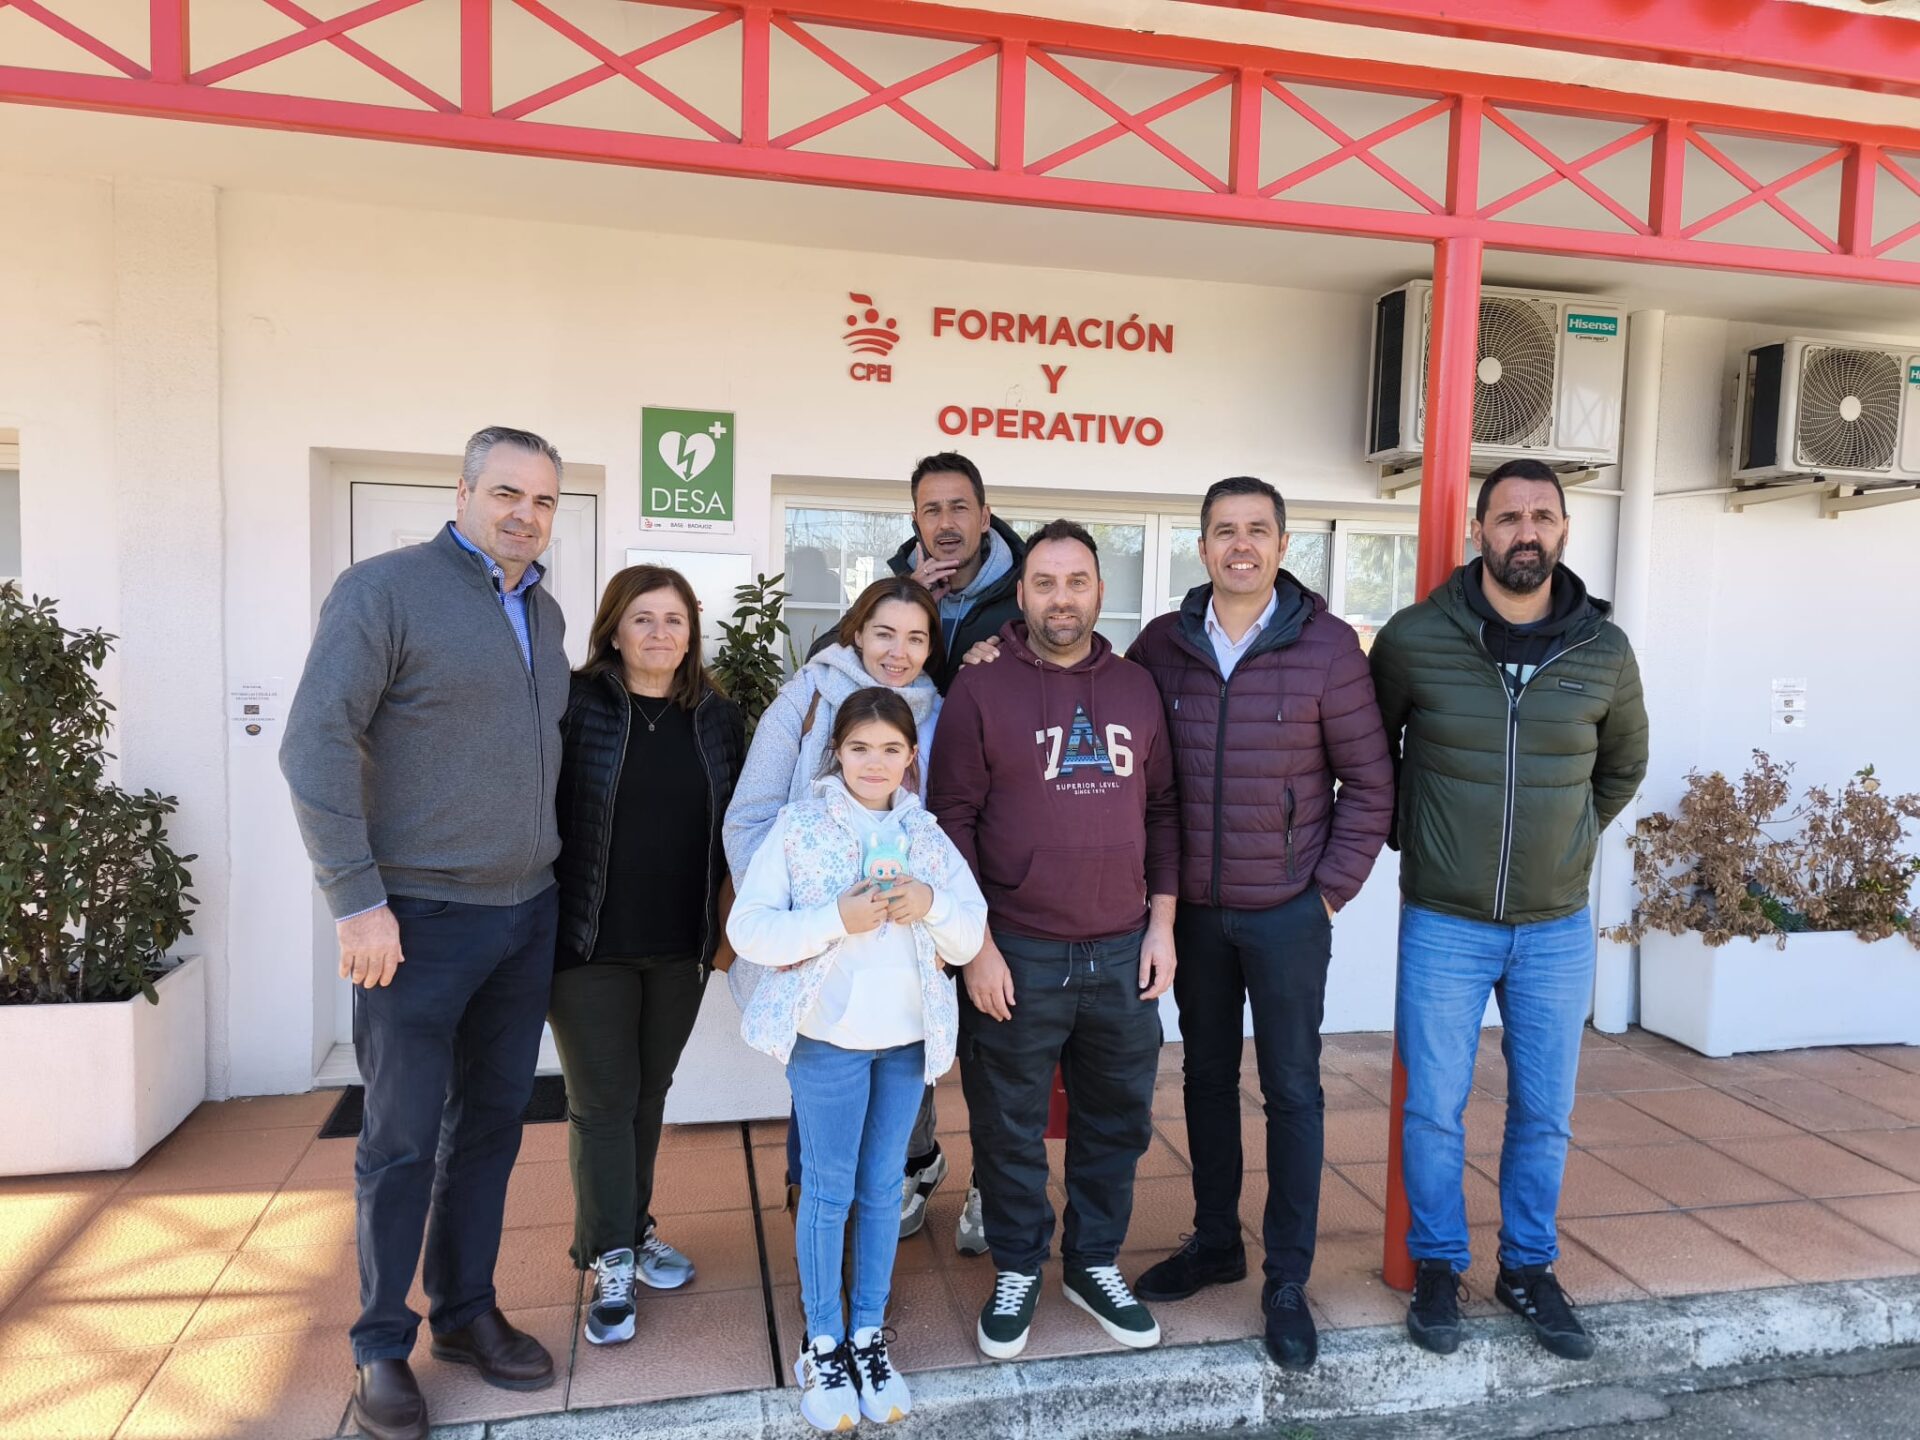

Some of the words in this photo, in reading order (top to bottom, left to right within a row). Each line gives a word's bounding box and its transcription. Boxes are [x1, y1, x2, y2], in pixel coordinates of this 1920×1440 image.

[932, 306, 1174, 354] FORMACIÓN
[1568, 318, 1616, 331] Hisense
[850, 362, 892, 383] CPEI
[1040, 363, 1067, 394] Y
[937, 404, 1164, 447] OPERATIVO
[651, 487, 726, 515] DESA
[1056, 782, 1096, 791] SUPERIOR
[1099, 781, 1120, 789] LEVEL
